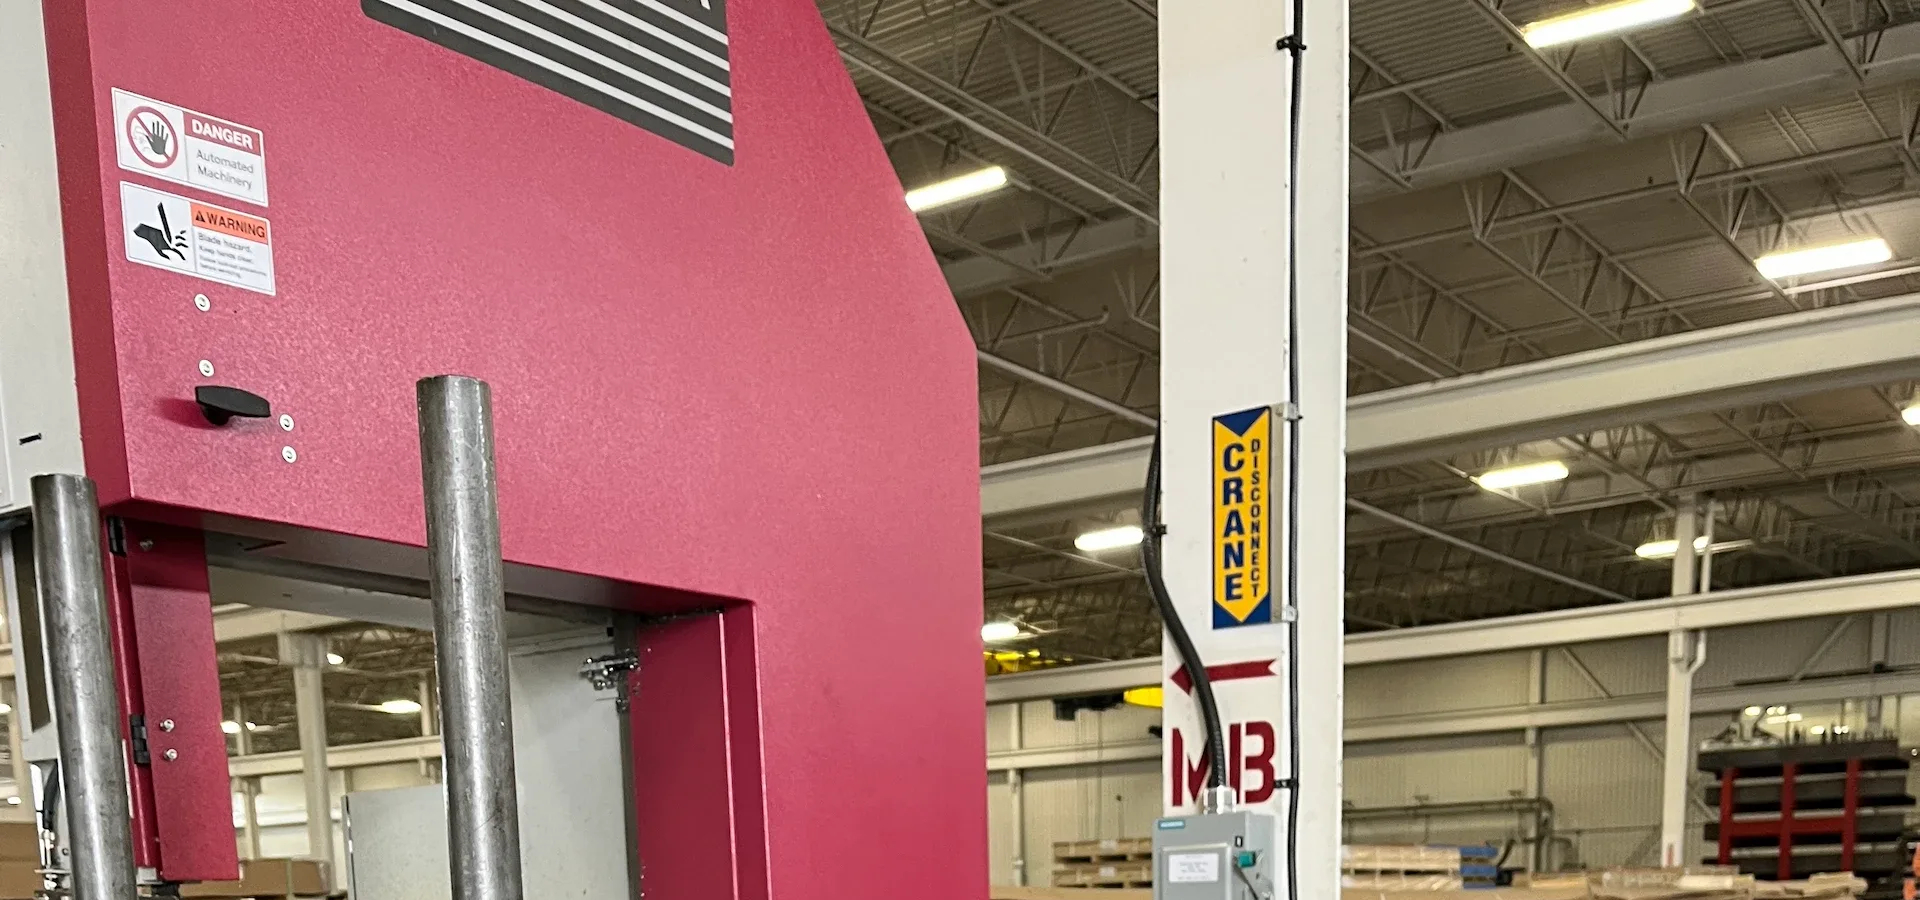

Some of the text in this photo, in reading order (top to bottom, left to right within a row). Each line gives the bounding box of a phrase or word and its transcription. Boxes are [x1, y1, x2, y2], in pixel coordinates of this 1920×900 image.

[191, 119, 253, 150] DANGER
[196, 149, 254, 174] Automated
[197, 164, 252, 191] Machinery
[206, 211, 265, 239] WARNING
[1222, 442, 1245, 602] CRANE
[1250, 438, 1261, 598] DISCONNECT
